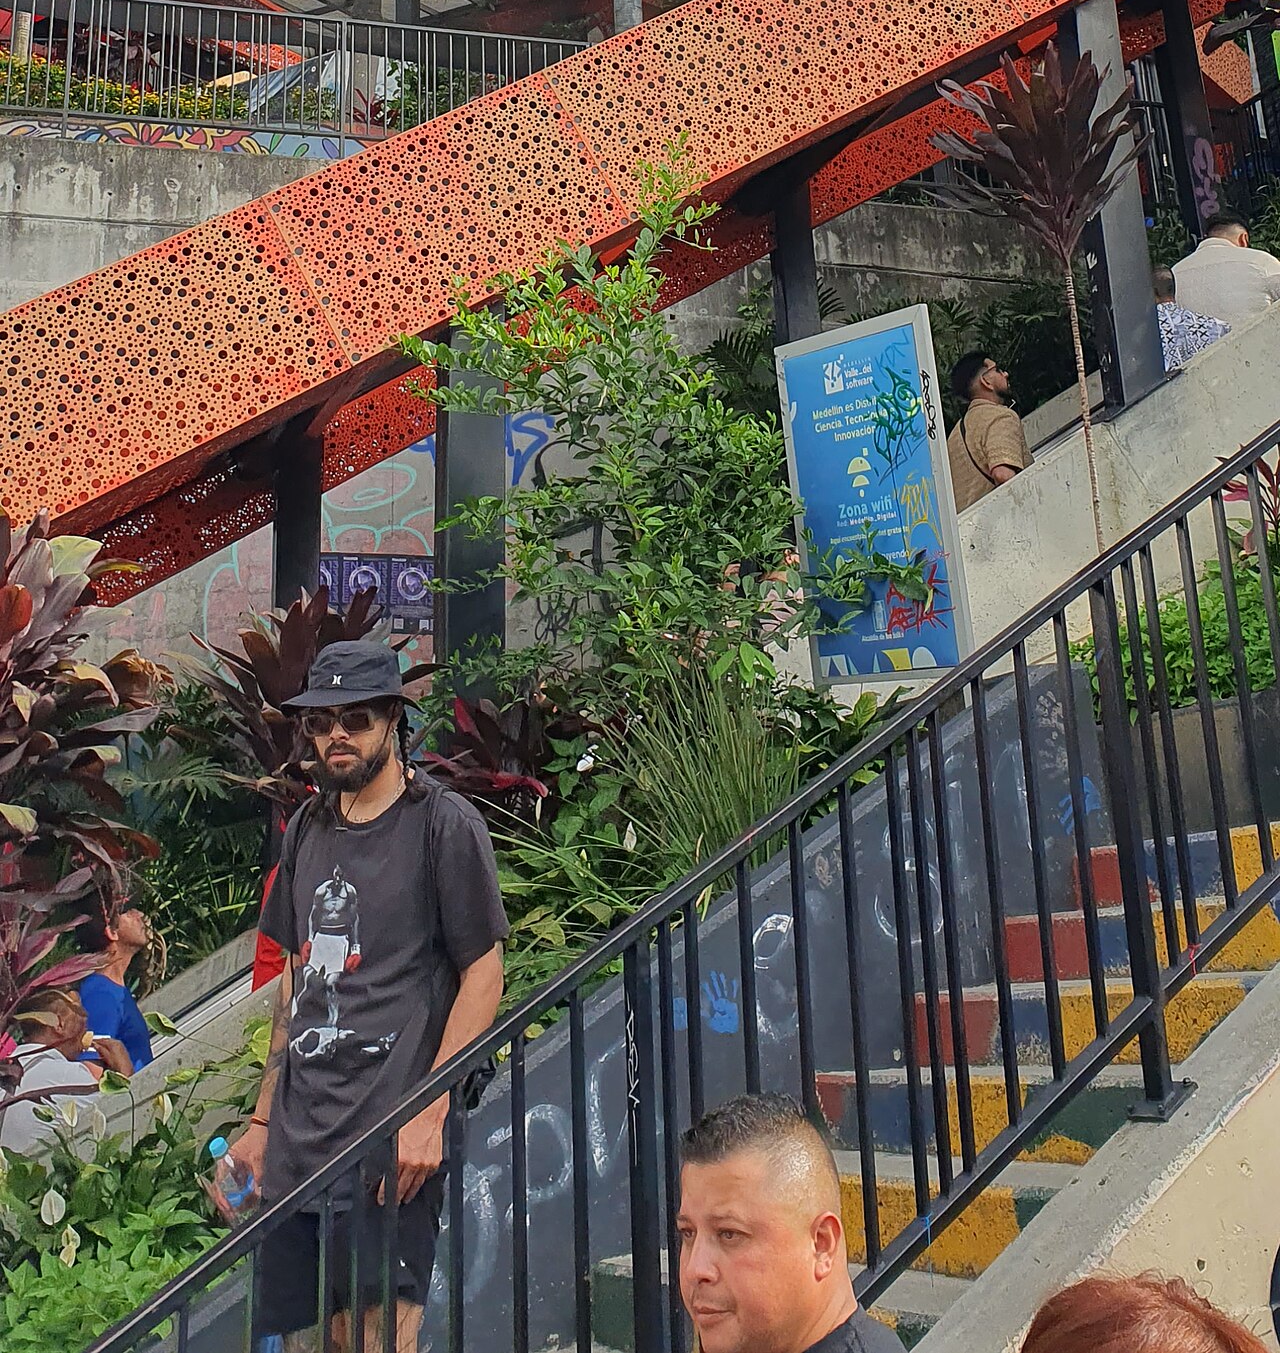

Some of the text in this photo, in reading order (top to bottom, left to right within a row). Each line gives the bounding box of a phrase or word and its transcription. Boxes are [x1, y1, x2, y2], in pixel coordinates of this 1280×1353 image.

[845, 376, 873, 390] software
[845, 402, 854, 412] es
[838, 495, 893, 519] Zona wifi
